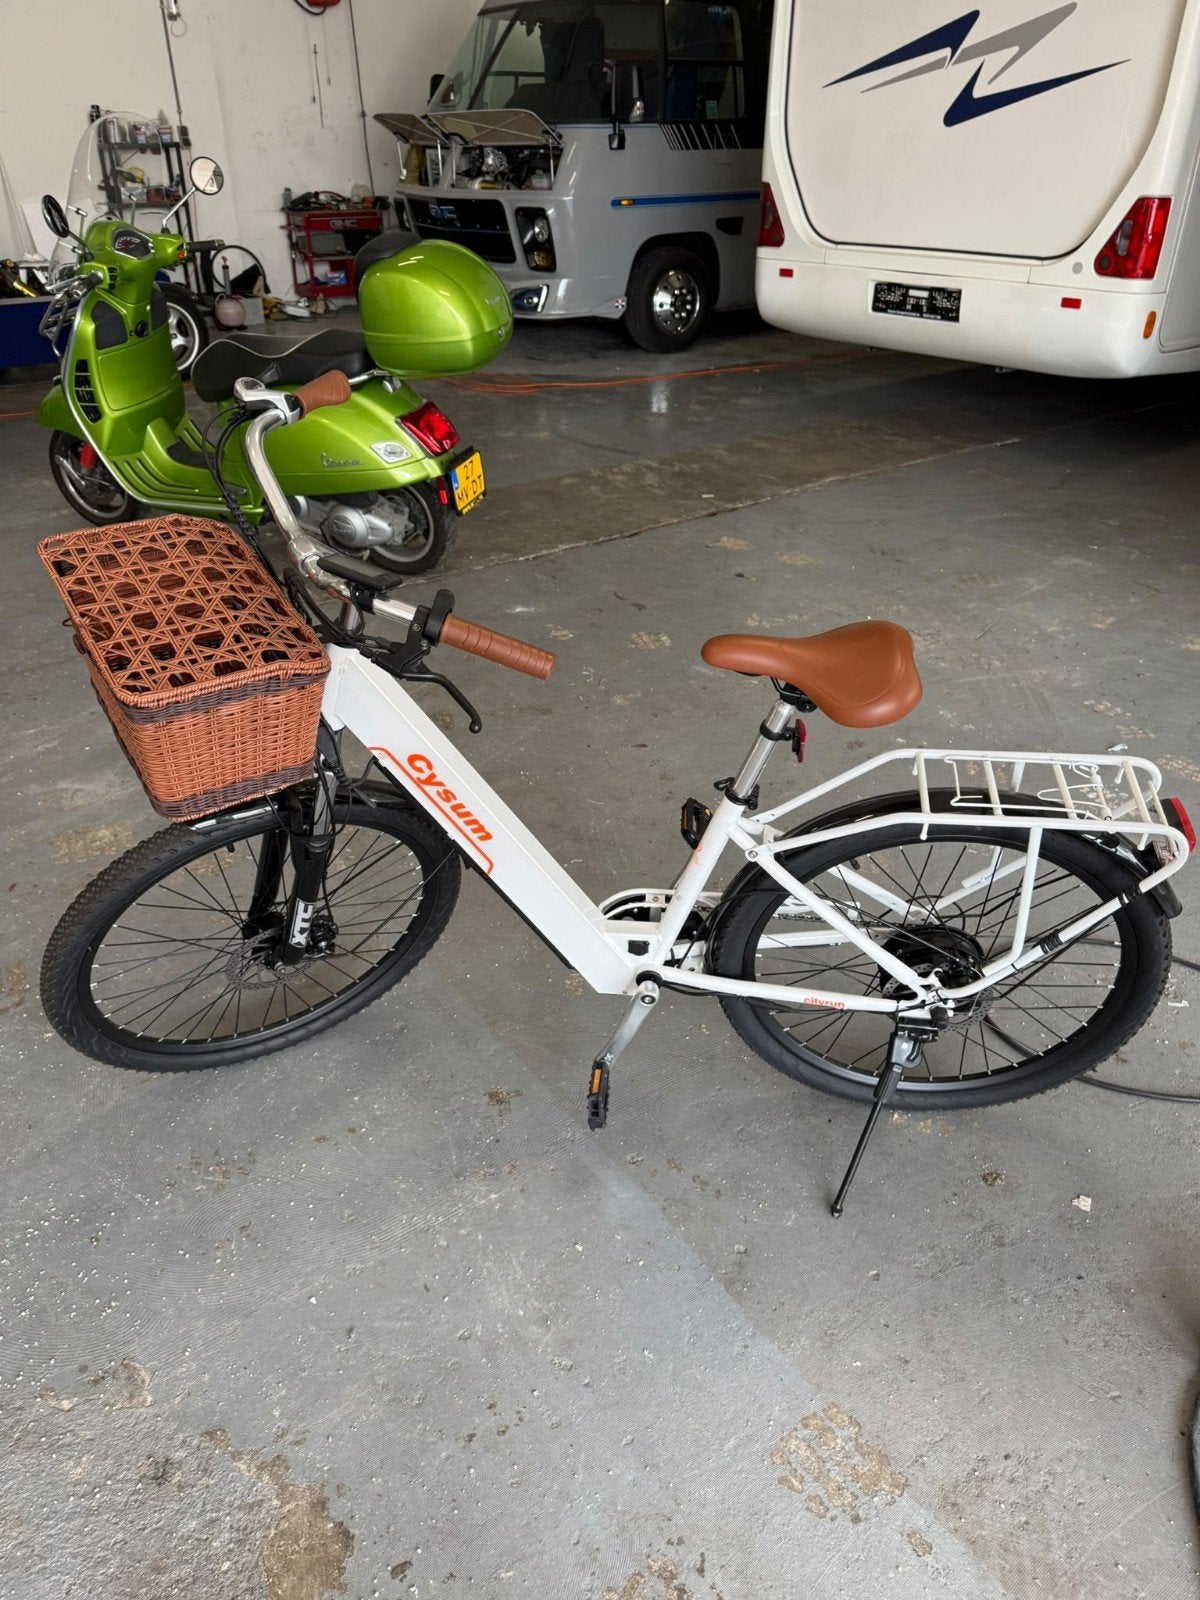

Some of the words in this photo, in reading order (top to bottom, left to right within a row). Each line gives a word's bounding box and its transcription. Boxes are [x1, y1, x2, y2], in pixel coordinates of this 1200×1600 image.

[329, 219, 358, 229] GMC
[463, 459, 475, 480] 27
[407, 753, 494, 842] Cysum
[291, 901, 314, 947] XTC
[803, 996, 846, 1009] cityrun
